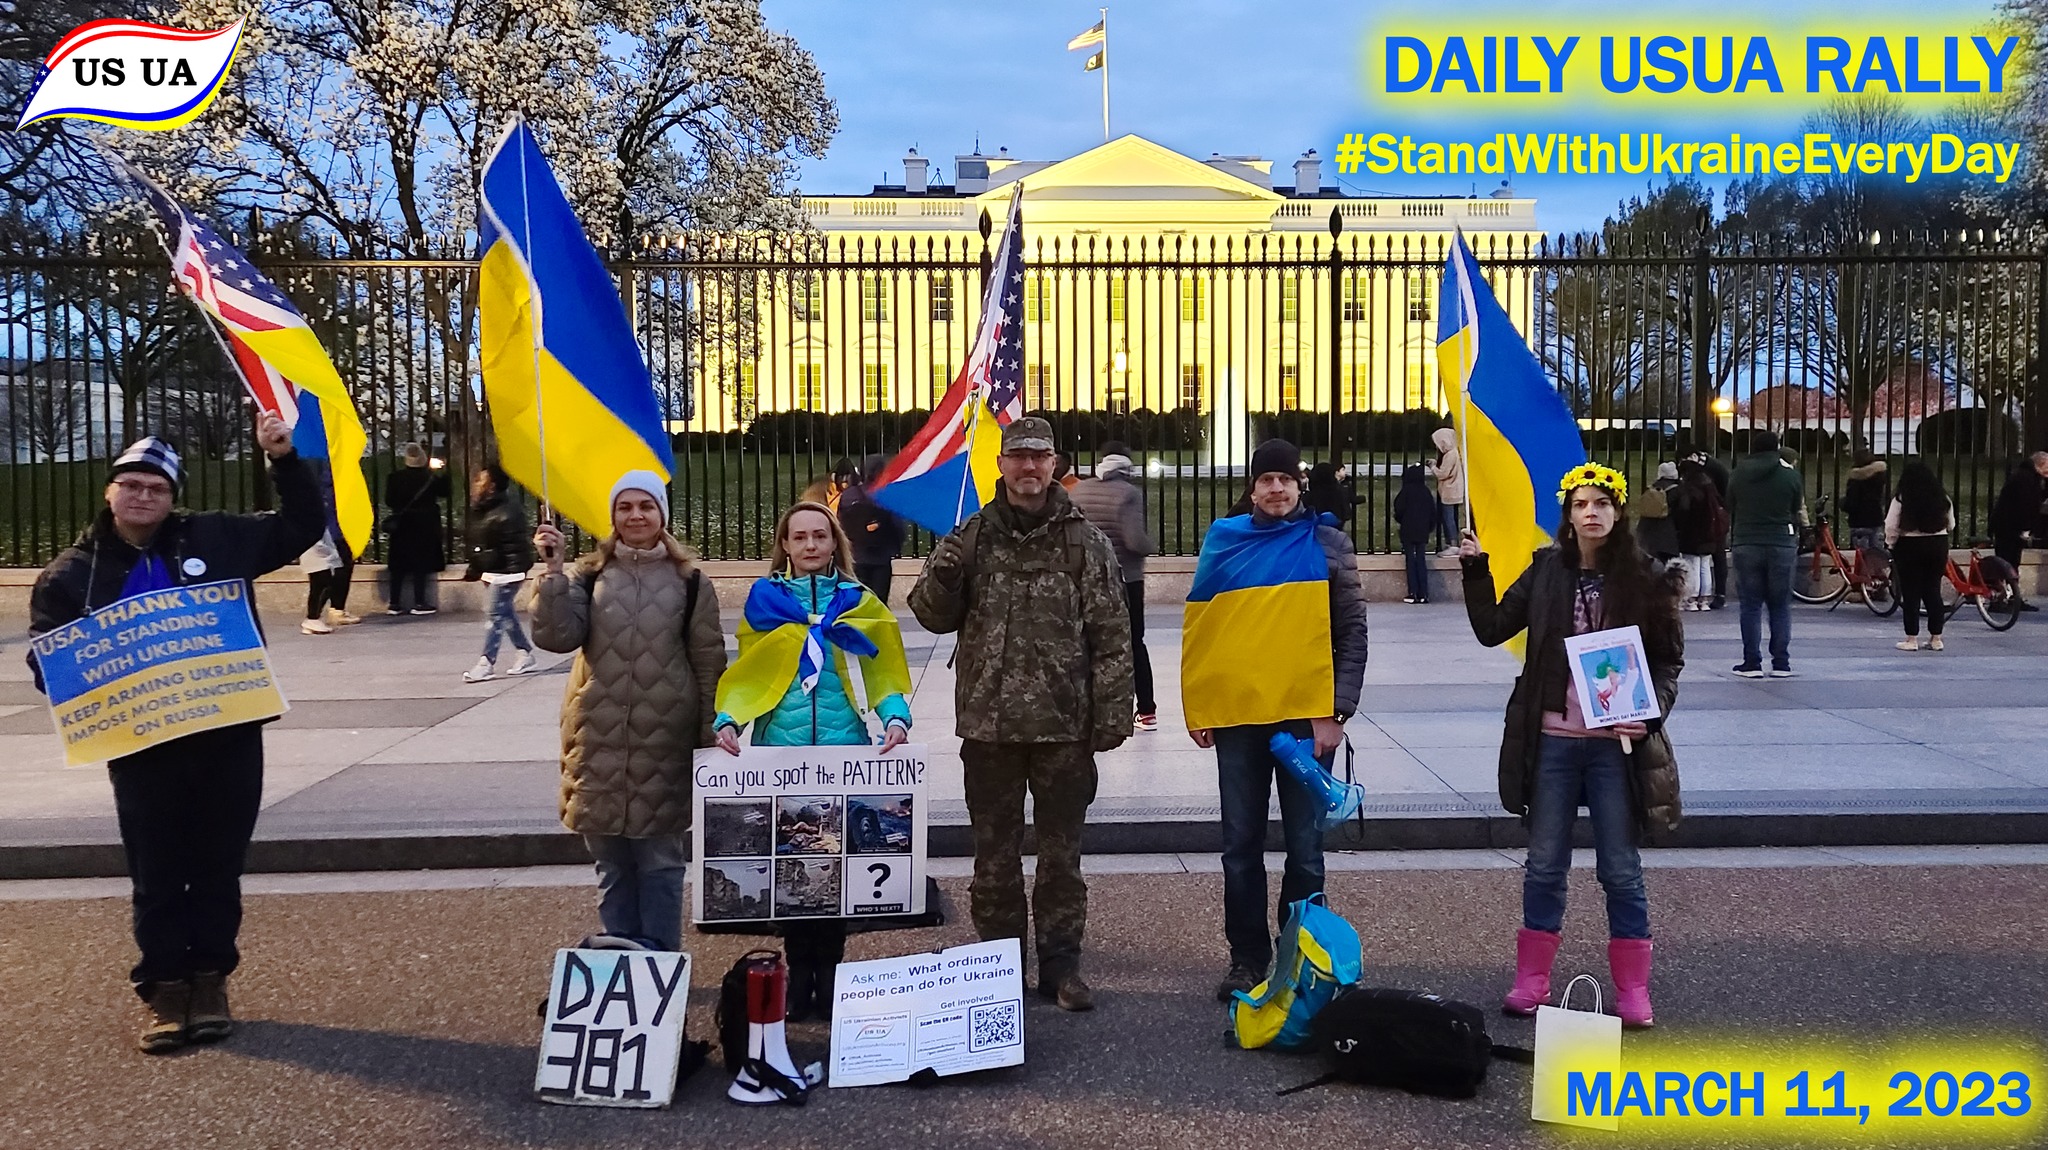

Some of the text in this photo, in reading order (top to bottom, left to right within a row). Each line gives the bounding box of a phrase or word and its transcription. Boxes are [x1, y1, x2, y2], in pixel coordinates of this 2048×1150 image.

[37, 583, 241, 656] USA, THANK YOU
[74, 611, 219, 664] FOR STANDING
[82, 633, 225, 684] WITH UKRAINE
[61, 658, 266, 728] KEEP ARMING UKRAINE
[67, 676, 270, 745] IMPOSE MORE SANCTIONS
[133, 702, 222, 737] ON RUSSIA
[695, 758, 926, 796] Can you spot the PATTERN?
[866, 862, 892, 899] ?
[557, 951, 687, 1028] DAY
[840, 966, 1015, 1002] people can do for Ukraine
[850, 952, 1003, 985] Ask me: What ordinary
[940, 993, 995, 1010] Get involved
[539, 1023, 651, 1099] 381
